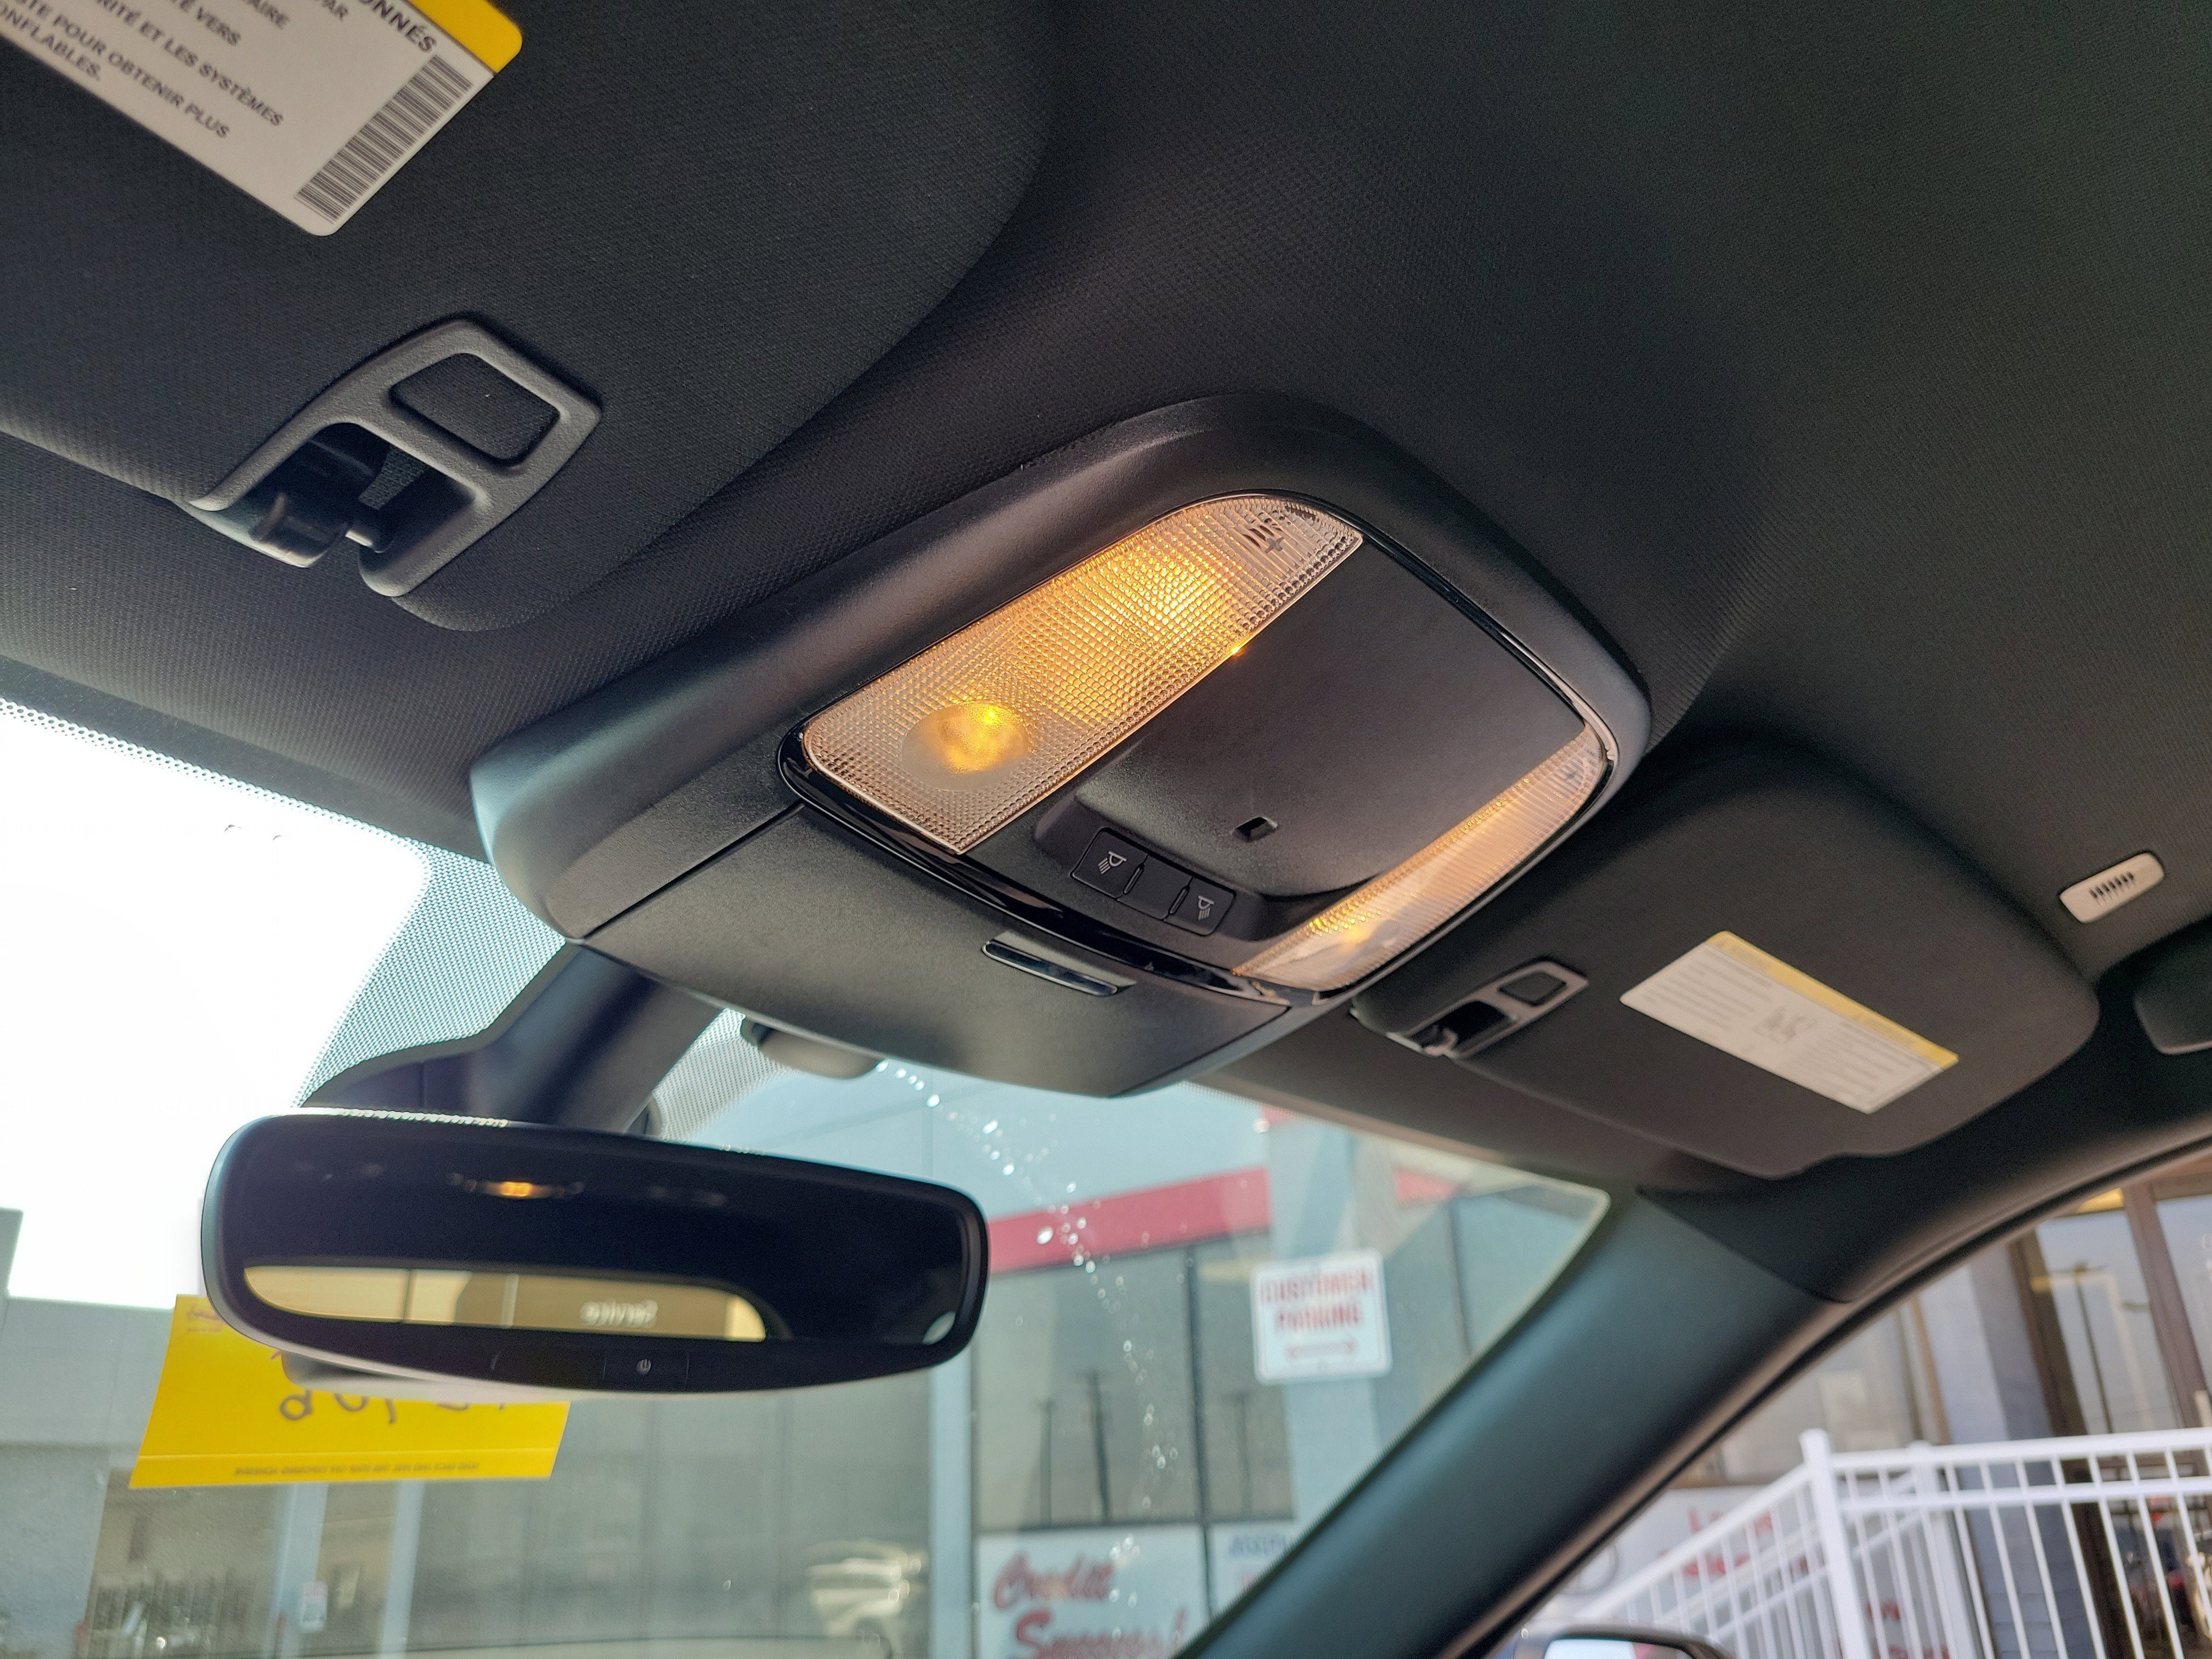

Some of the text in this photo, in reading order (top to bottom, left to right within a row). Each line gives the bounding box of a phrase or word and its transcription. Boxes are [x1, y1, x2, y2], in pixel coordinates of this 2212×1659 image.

[197, 7, 241, 46] VERS
[359, 0, 437, 52] NNÉS
[53, 13, 106, 55] POUR
[108, 52, 184, 108] OBTENIR
[185, 102, 230, 138] PLUS
[140, 21, 165, 42] ET
[163, 37, 198, 67] LES
[199, 62, 284, 126] SYSTÈMES
